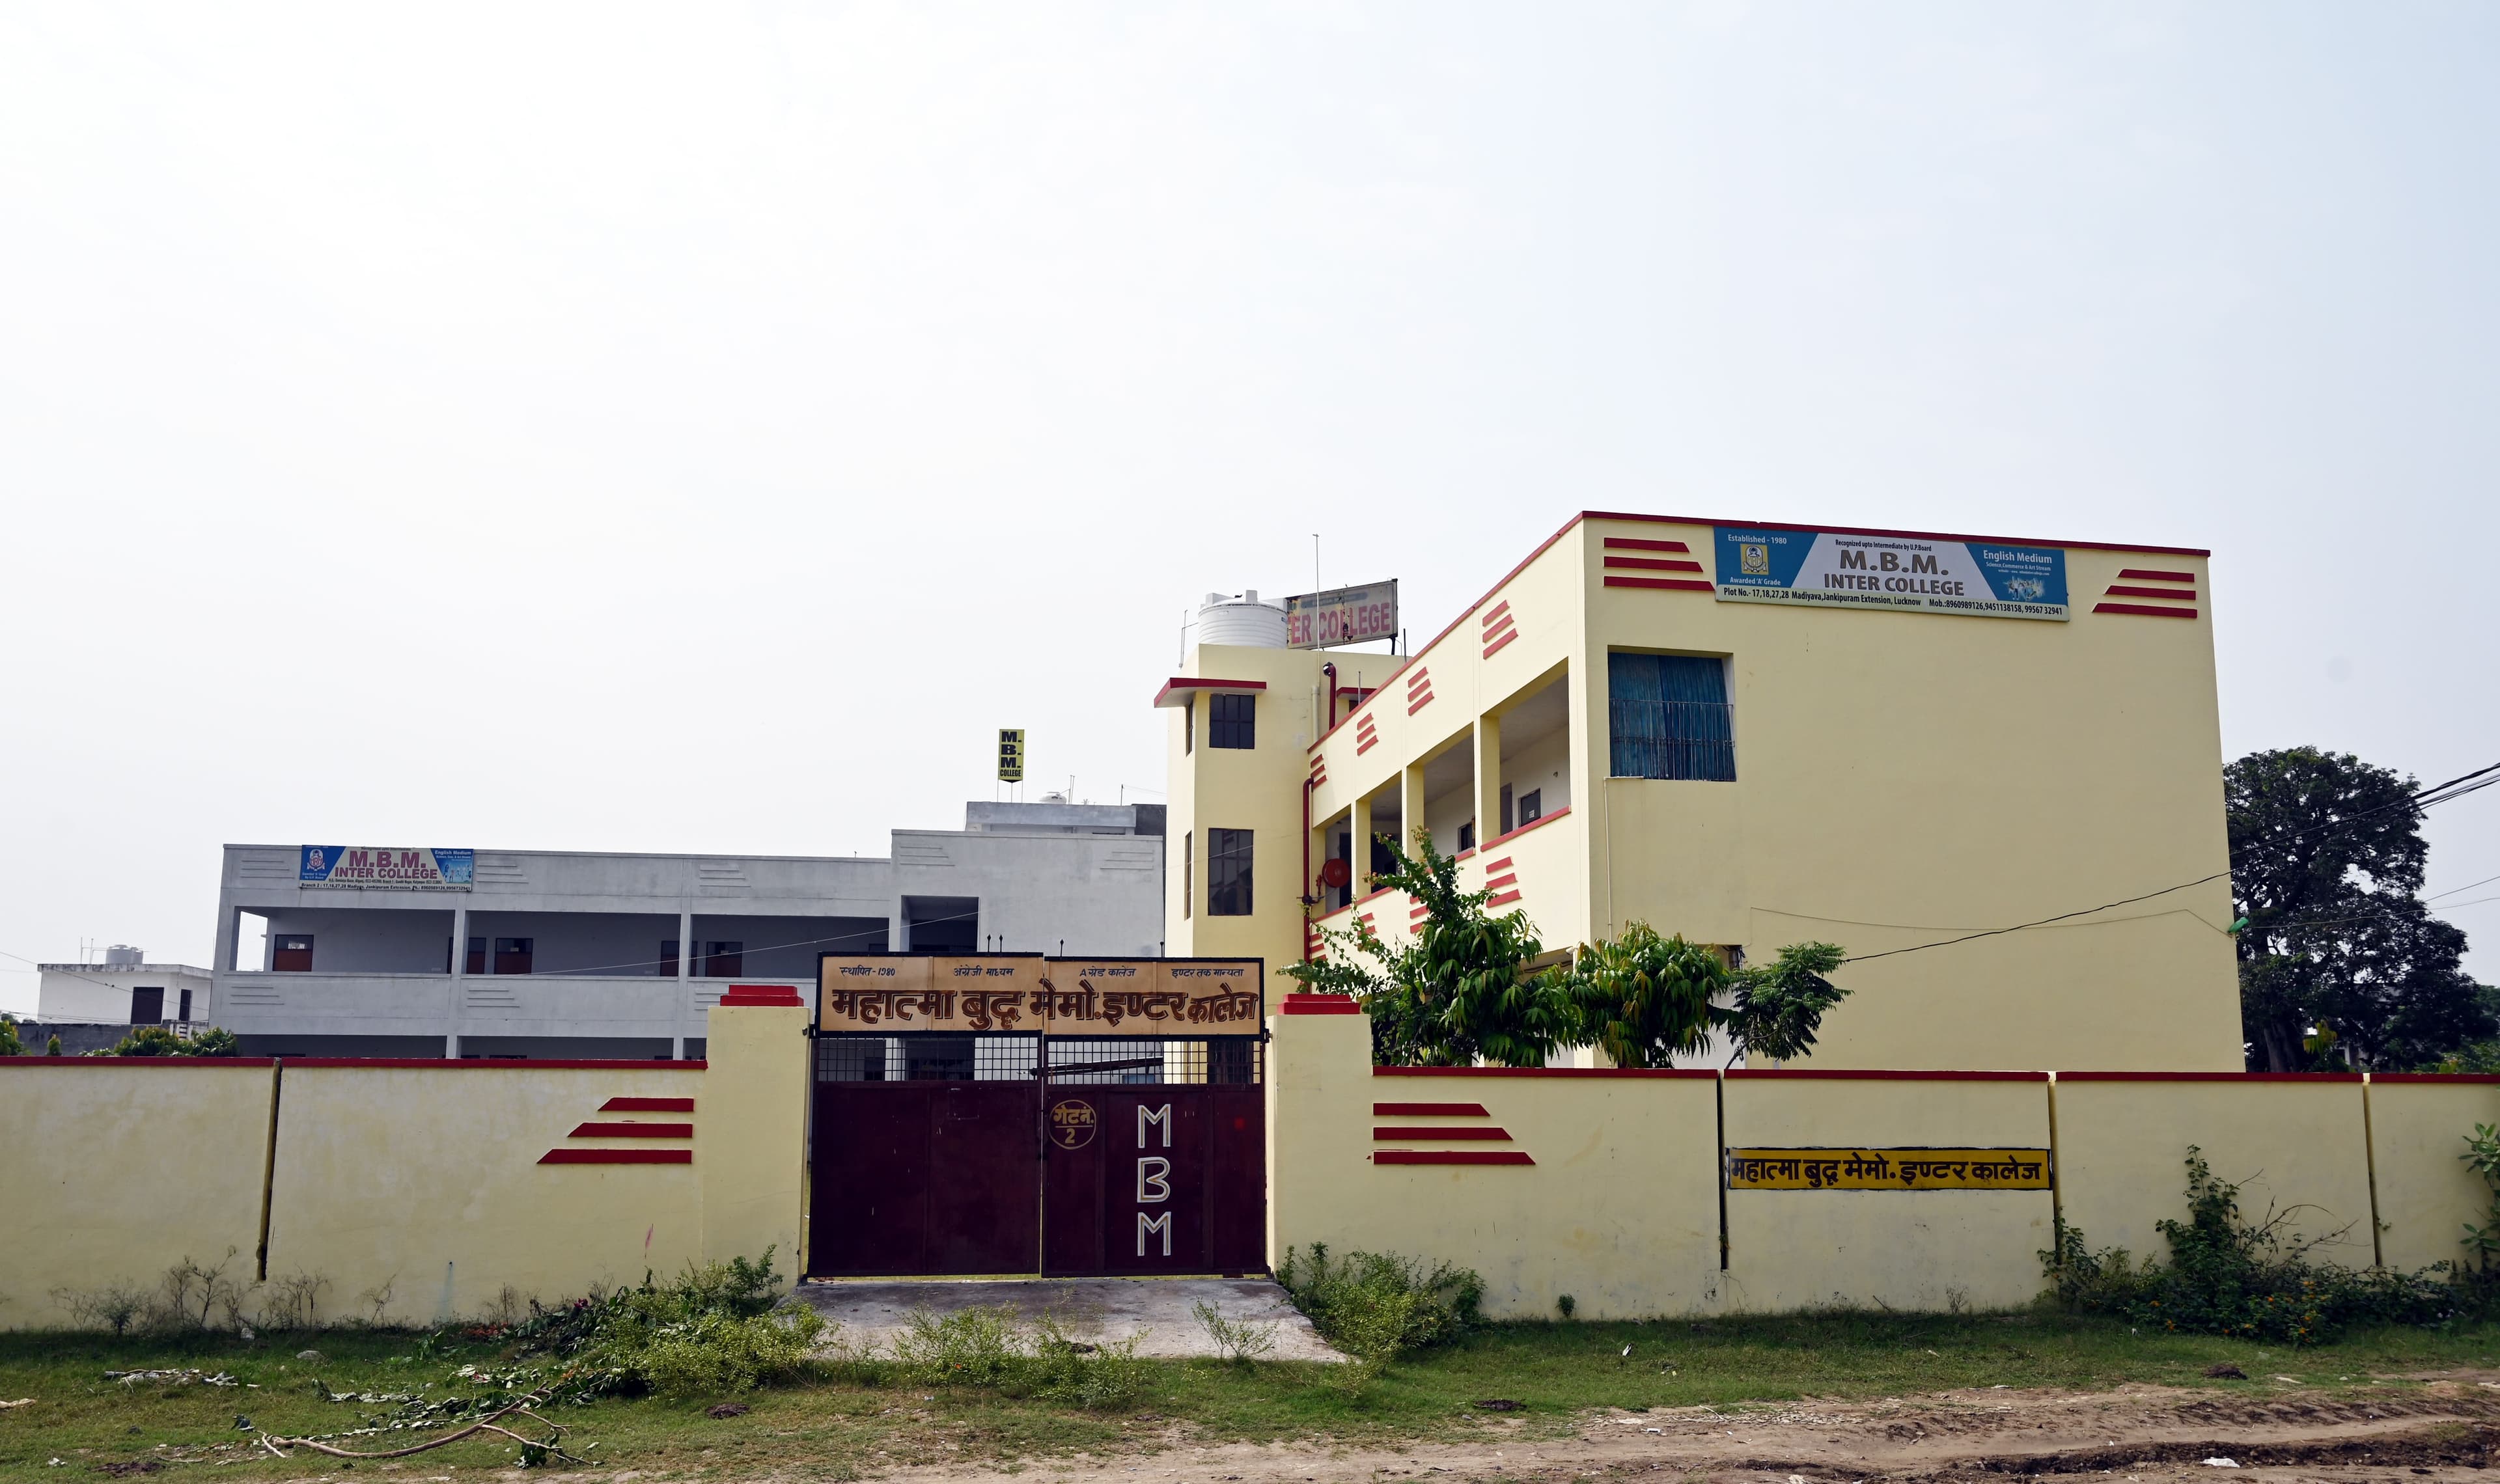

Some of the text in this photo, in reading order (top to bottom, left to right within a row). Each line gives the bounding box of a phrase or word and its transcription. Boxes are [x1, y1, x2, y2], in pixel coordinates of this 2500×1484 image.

[1728, 534, 1766, 543] Established
[1835, 539, 1861, 547] Recognized
[1874, 542, 1903, 550] Intermediate
[1840, 549, 1949, 575] M.B.M.
[1983, 549, 2052, 564] English Medium
[1824, 573, 1965, 596] INTER COLLEGE
[1753, 589, 1789, 599] 17,18,27,28
[1861, 594, 1893, 605] Extension,
[1895, 597, 1921, 606] Lucknow
[2025, 605, 2043, 614] 99567
[2044, 606, 2062, 615] 32941
[1318, 602, 1391, 641] COLLEGE
[1000, 769, 1021, 777] COLLEGE
[349, 851, 426, 868] M.B.M.
[335, 867, 438, 879] INTER COLLEGE
[953, 964, 983, 976] अंग्रेजी
[1088, 965, 1106, 977] ग्रेड
[1171, 969, 1244, 978] इण्टर तक मान्यता
[832, 989, 957, 1024] महात्मा
[1188, 982, 1259, 1024] कालेज
[1065, 1128, 1076, 1144] 2
[1732, 1159, 1801, 1183] महात्मा
[1898, 1161, 1969, 1186] इण्टर
[1971, 1154, 2042, 1181] कालेज
